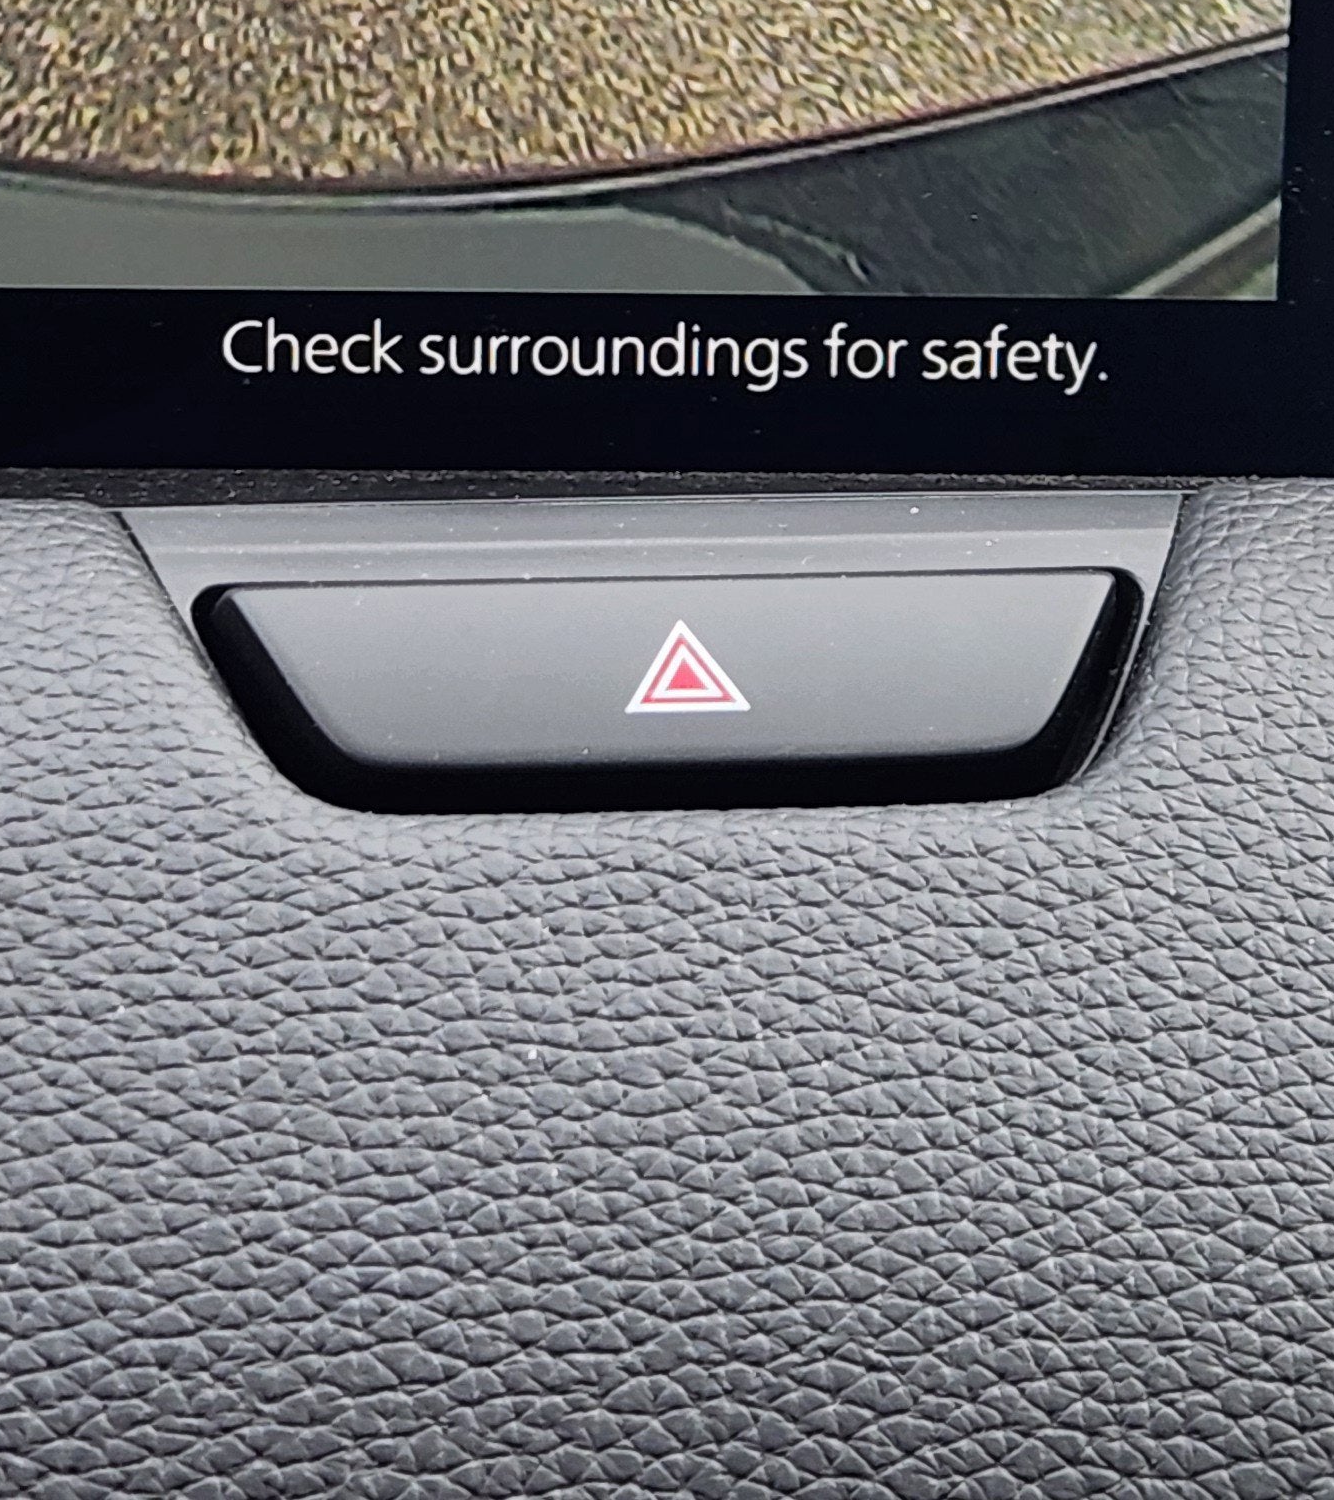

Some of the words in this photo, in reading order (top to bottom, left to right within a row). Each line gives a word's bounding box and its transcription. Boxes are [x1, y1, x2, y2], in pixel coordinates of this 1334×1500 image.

[221, 316, 405, 374] Check
[418, 320, 810, 393] surroundings
[822, 321, 909, 380] for
[921, 323, 1110, 396] safety.
